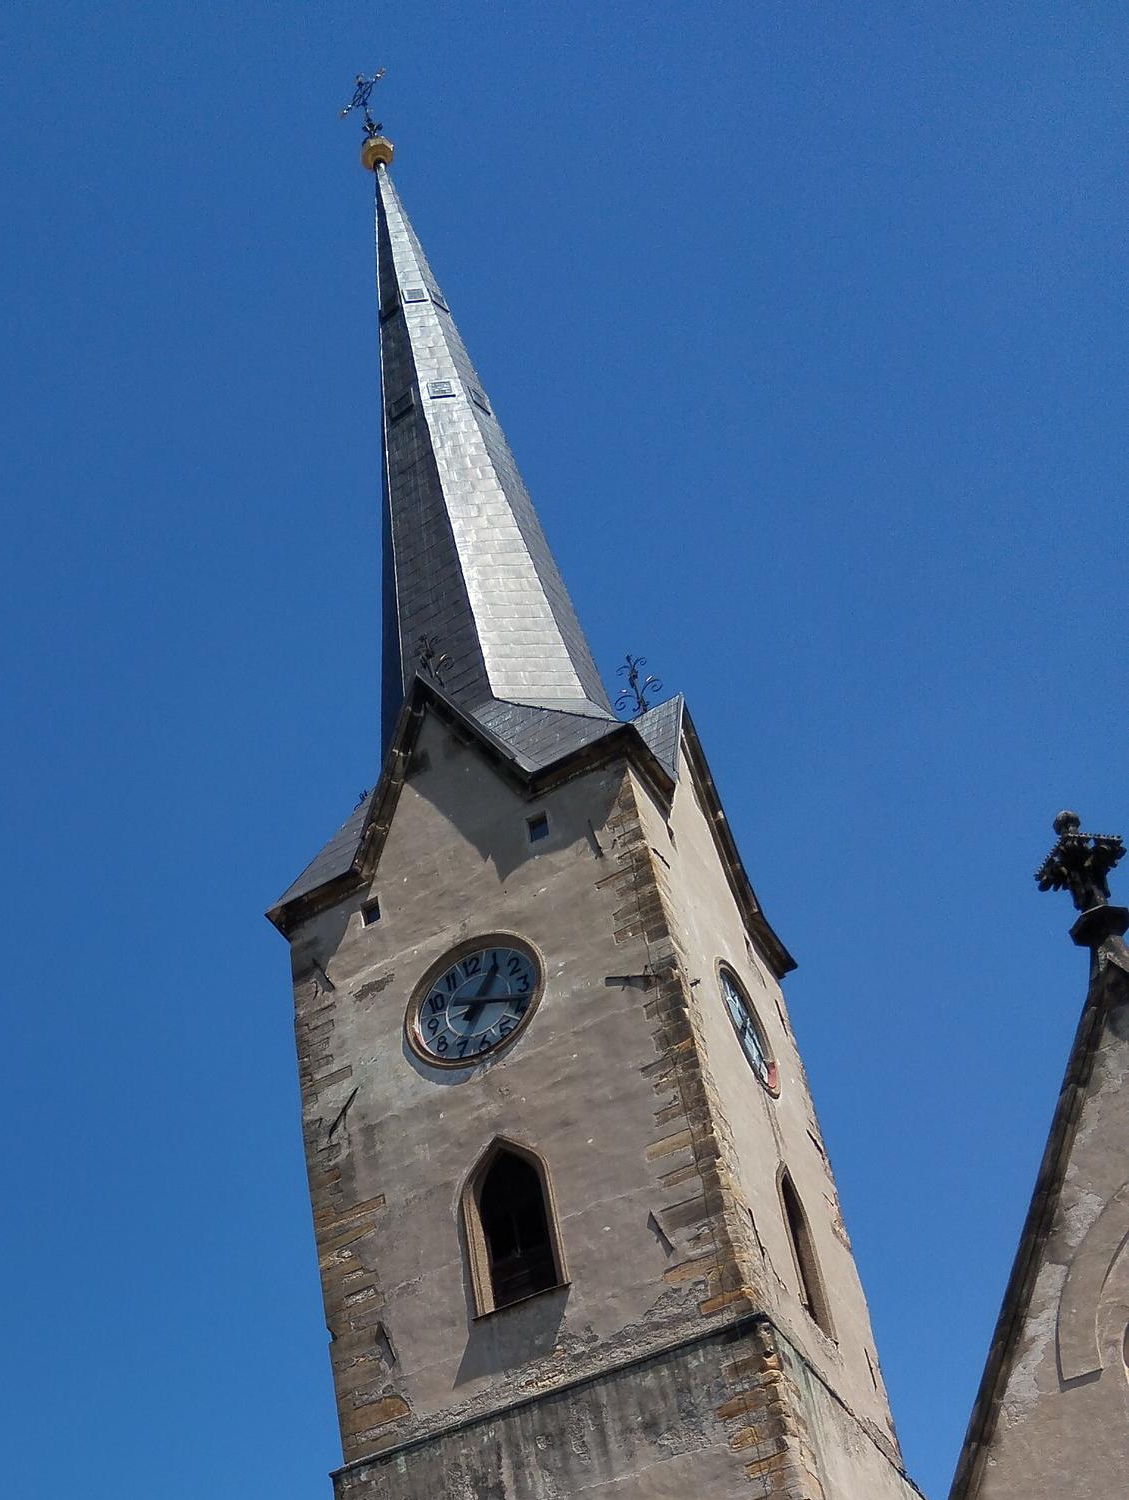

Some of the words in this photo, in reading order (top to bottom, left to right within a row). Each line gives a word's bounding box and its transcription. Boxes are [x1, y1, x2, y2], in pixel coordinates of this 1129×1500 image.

[462, 957, 482, 976] 12
[507, 957, 521, 977] 2
[445, 973, 458, 992] 11
[517, 974, 530, 993] 3
[428, 994, 445, 1014] 10
[427, 1018, 440, 1036] 9
[499, 1019, 513, 1037] 5
[437, 1035, 449, 1053] 8
[456, 1038, 469, 1058] 7
